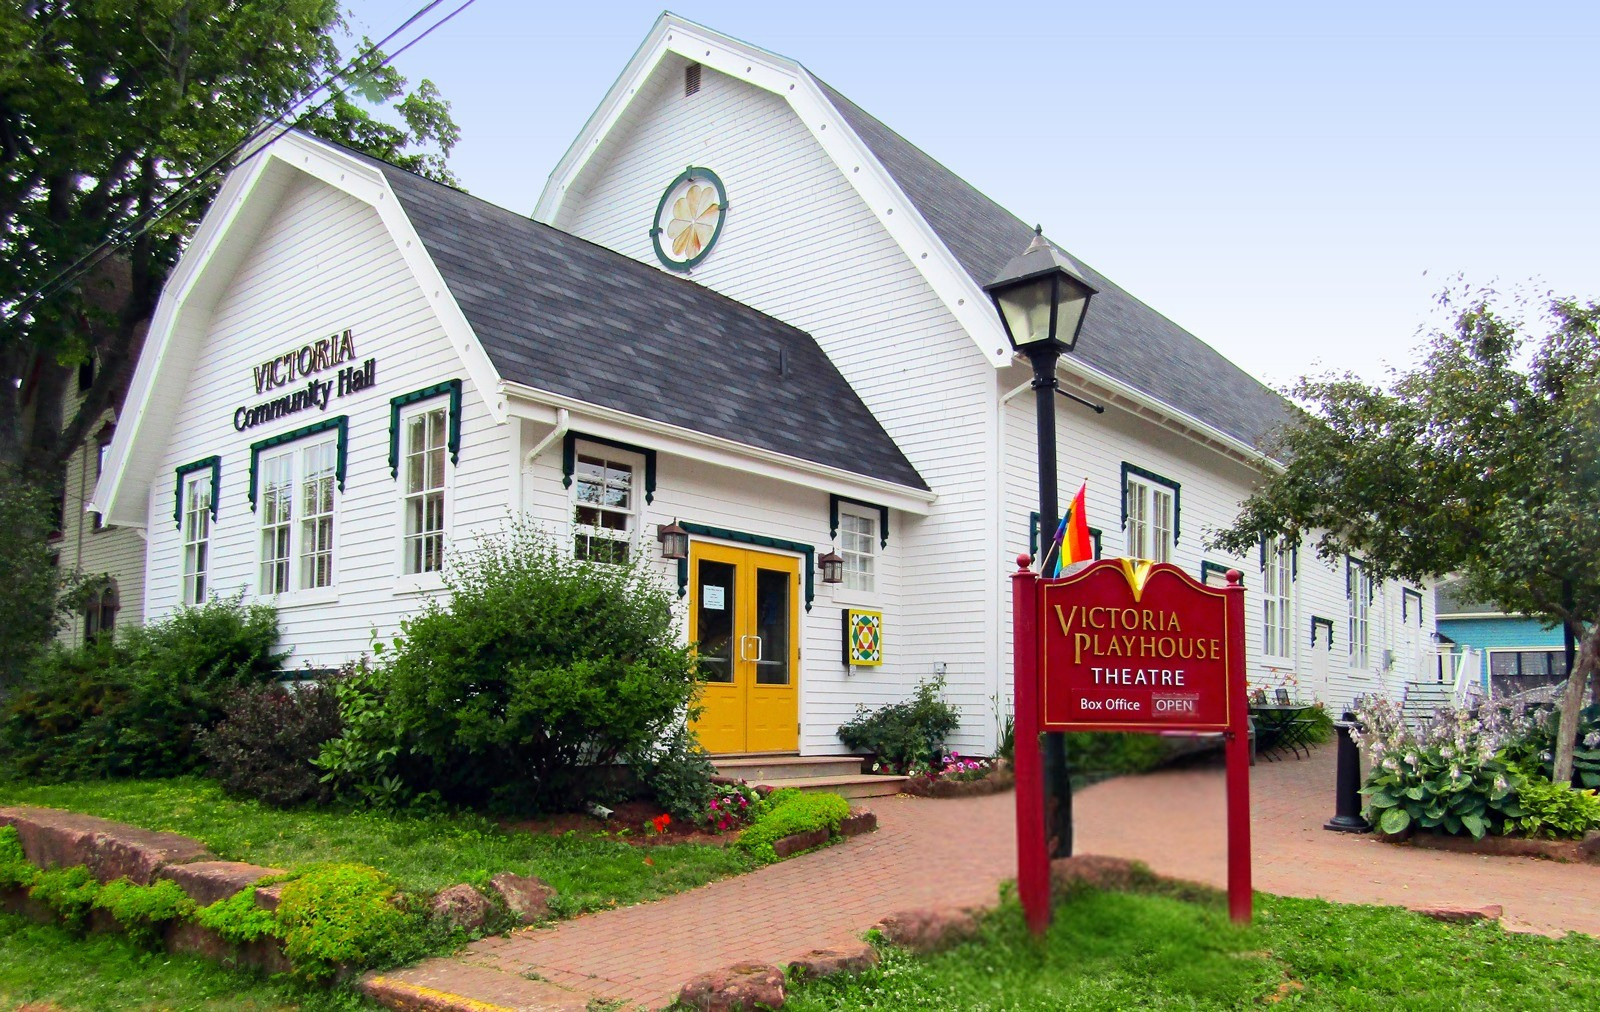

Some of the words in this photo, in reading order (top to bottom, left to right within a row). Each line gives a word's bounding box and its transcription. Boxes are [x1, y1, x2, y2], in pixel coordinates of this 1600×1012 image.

[253, 329, 356, 395] VICTORIA
[233, 379, 333, 432] Community
[337, 358, 376, 397] Hall
[1054, 604, 1181, 637] VICTORIA
[1074, 633, 1220, 664] PLAYHOUSE
[1091, 667, 1185, 686] THEATRE
[1080, 698, 1102, 710] Box
[1106, 698, 1140, 711] Office
[1156, 699, 1193, 711] OPEN
